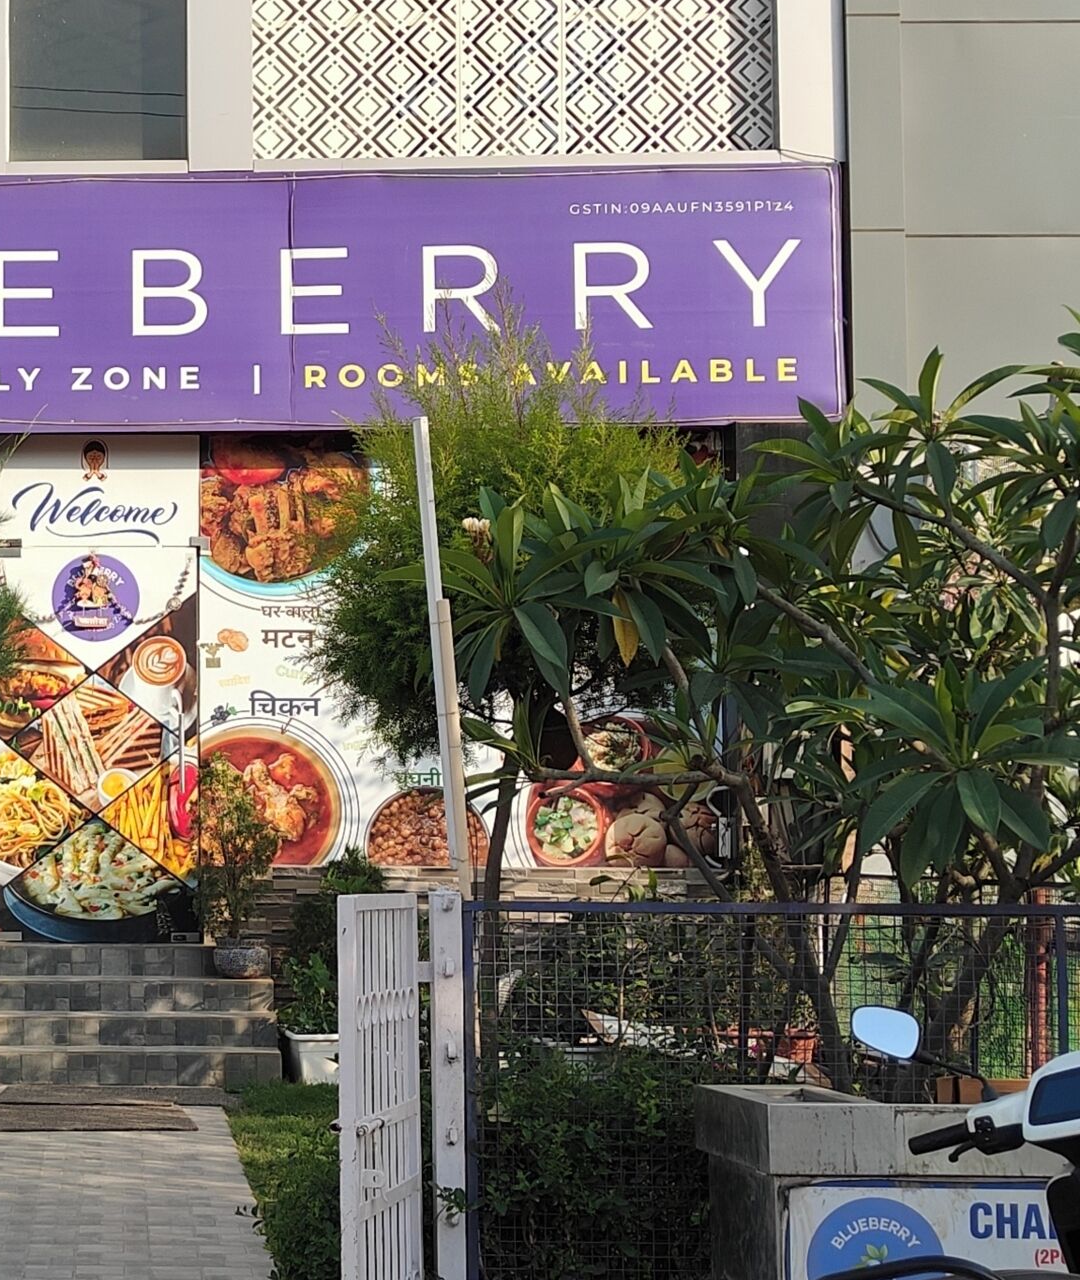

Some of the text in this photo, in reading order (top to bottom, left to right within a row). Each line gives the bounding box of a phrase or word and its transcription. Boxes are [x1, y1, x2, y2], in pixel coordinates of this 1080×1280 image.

[70, 366, 201, 391] ZONE
[304, 362, 479, 388] ROOMS
[511, 357, 799, 385] AVAILABLE
[11, 482, 178, 532] Welcome
[261, 629, 316, 649] मटन
[249, 689, 322, 717] चिकन
[829, 1216, 921, 1250] BLUEBERRY
